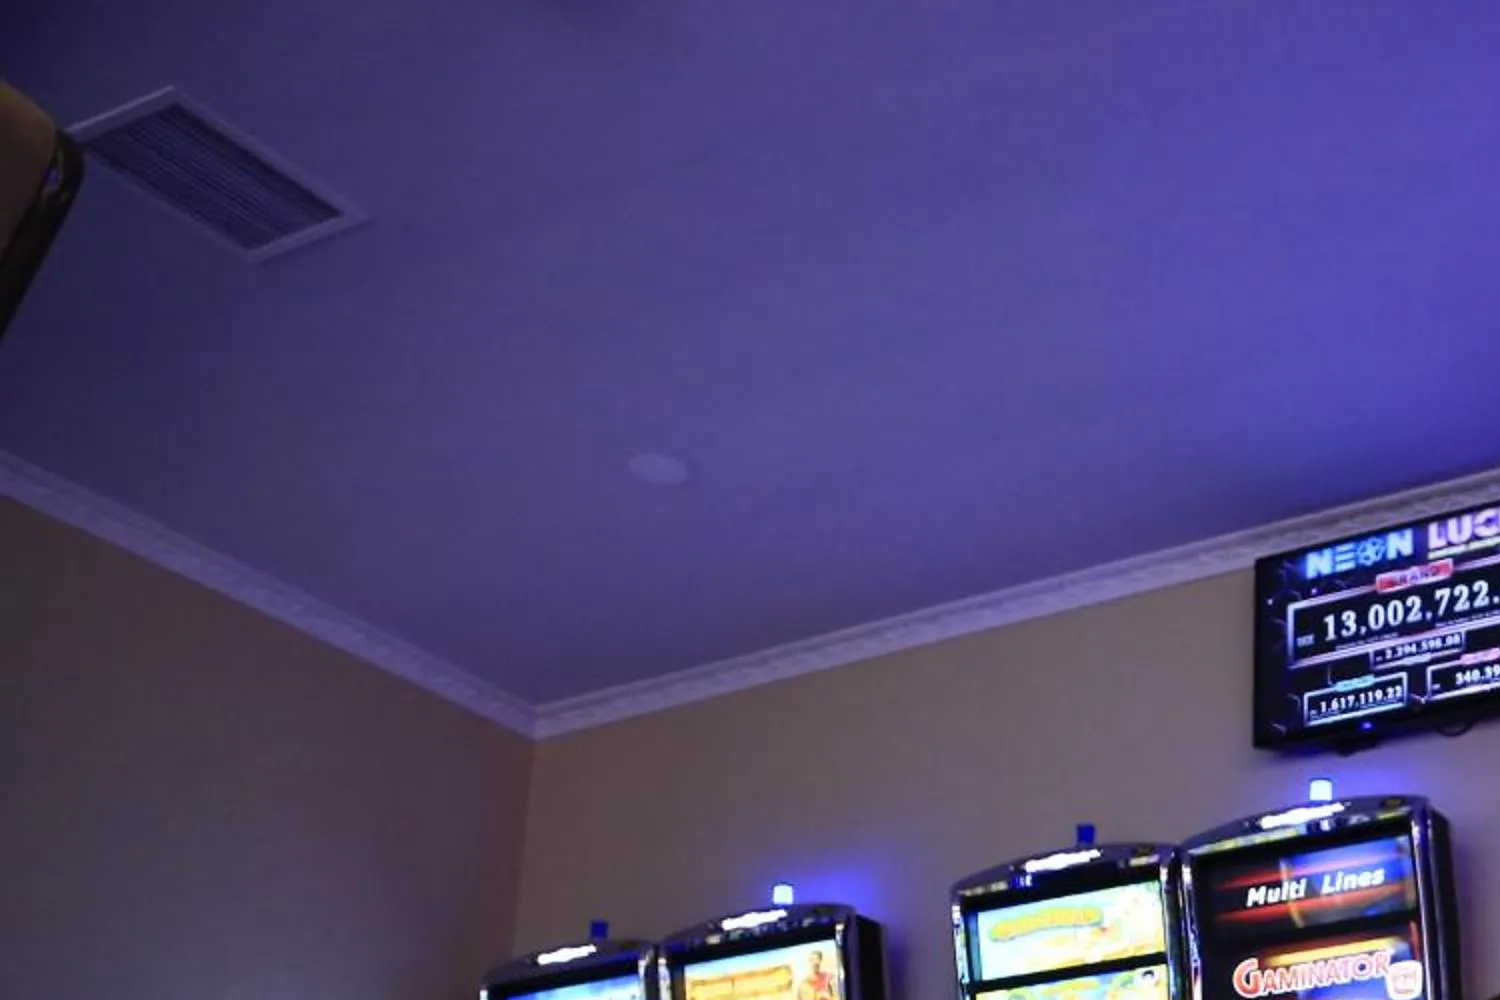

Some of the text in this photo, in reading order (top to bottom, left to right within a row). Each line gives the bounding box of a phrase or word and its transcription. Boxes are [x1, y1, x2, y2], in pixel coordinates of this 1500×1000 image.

[1306, 529, 1413, 579] NEON
[1246, 866, 1386, 908] Multi Lines
[1233, 949, 1393, 999] GAMINATOR
